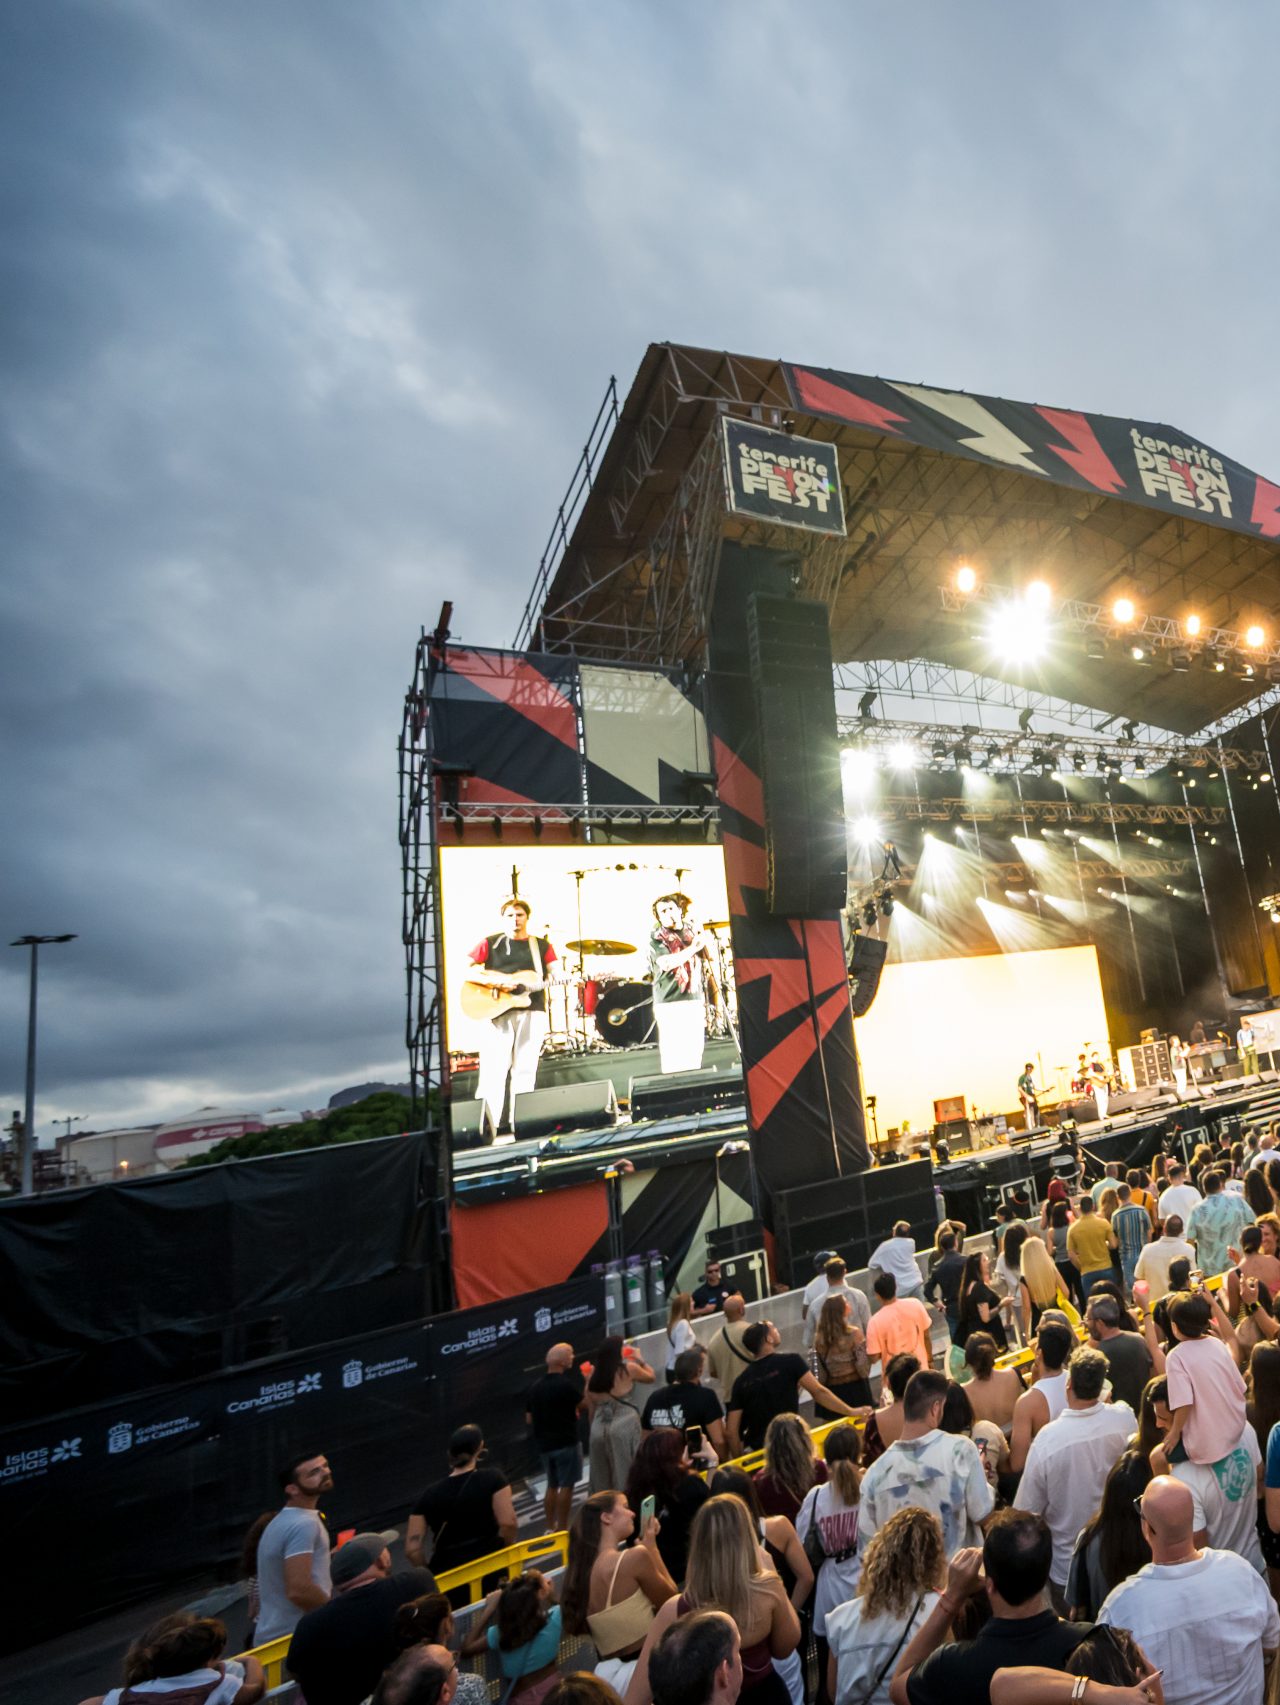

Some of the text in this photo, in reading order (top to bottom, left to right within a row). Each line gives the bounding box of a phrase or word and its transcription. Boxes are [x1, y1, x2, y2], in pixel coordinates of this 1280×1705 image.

[738, 442, 828, 477] tenerife
[1130, 428, 1224, 473] tenerife
[742, 474, 828, 512] FEST
[1140, 470, 1232, 518] FEST
[441, 1333, 497, 1355] Canarias
[467, 1325, 497, 1340] Islas
[260, 1380, 296, 1396] Islas
[227, 1388, 296, 1413] Canarias
[135, 1416, 190, 1436] Gobierno
[135, 1421, 201, 1445] de Canarias
[6, 1447, 49, 1466] Islas
